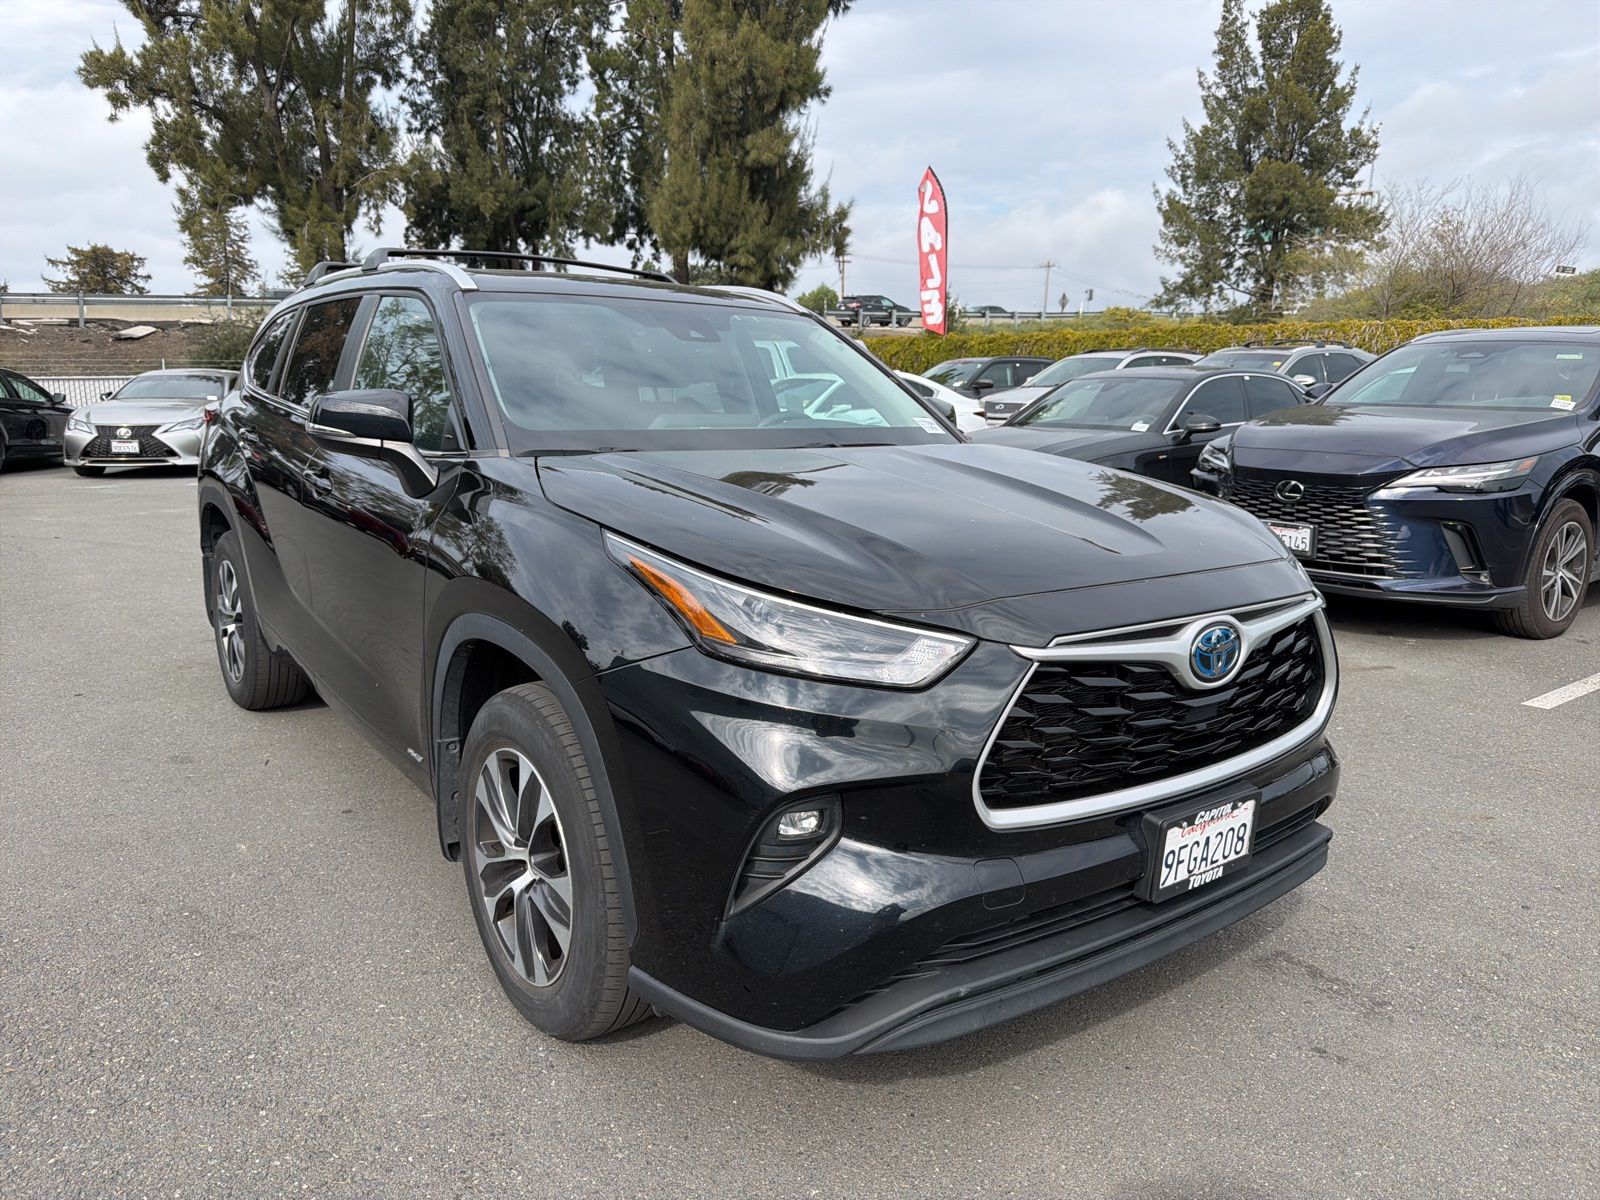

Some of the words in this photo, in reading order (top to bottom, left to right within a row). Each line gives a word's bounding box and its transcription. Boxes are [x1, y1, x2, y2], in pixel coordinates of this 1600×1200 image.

[1194, 802, 1234, 824] CAPITOL
[1161, 822, 1247, 887] 9FGA208
[1188, 866, 1223, 890] TOYOTA
